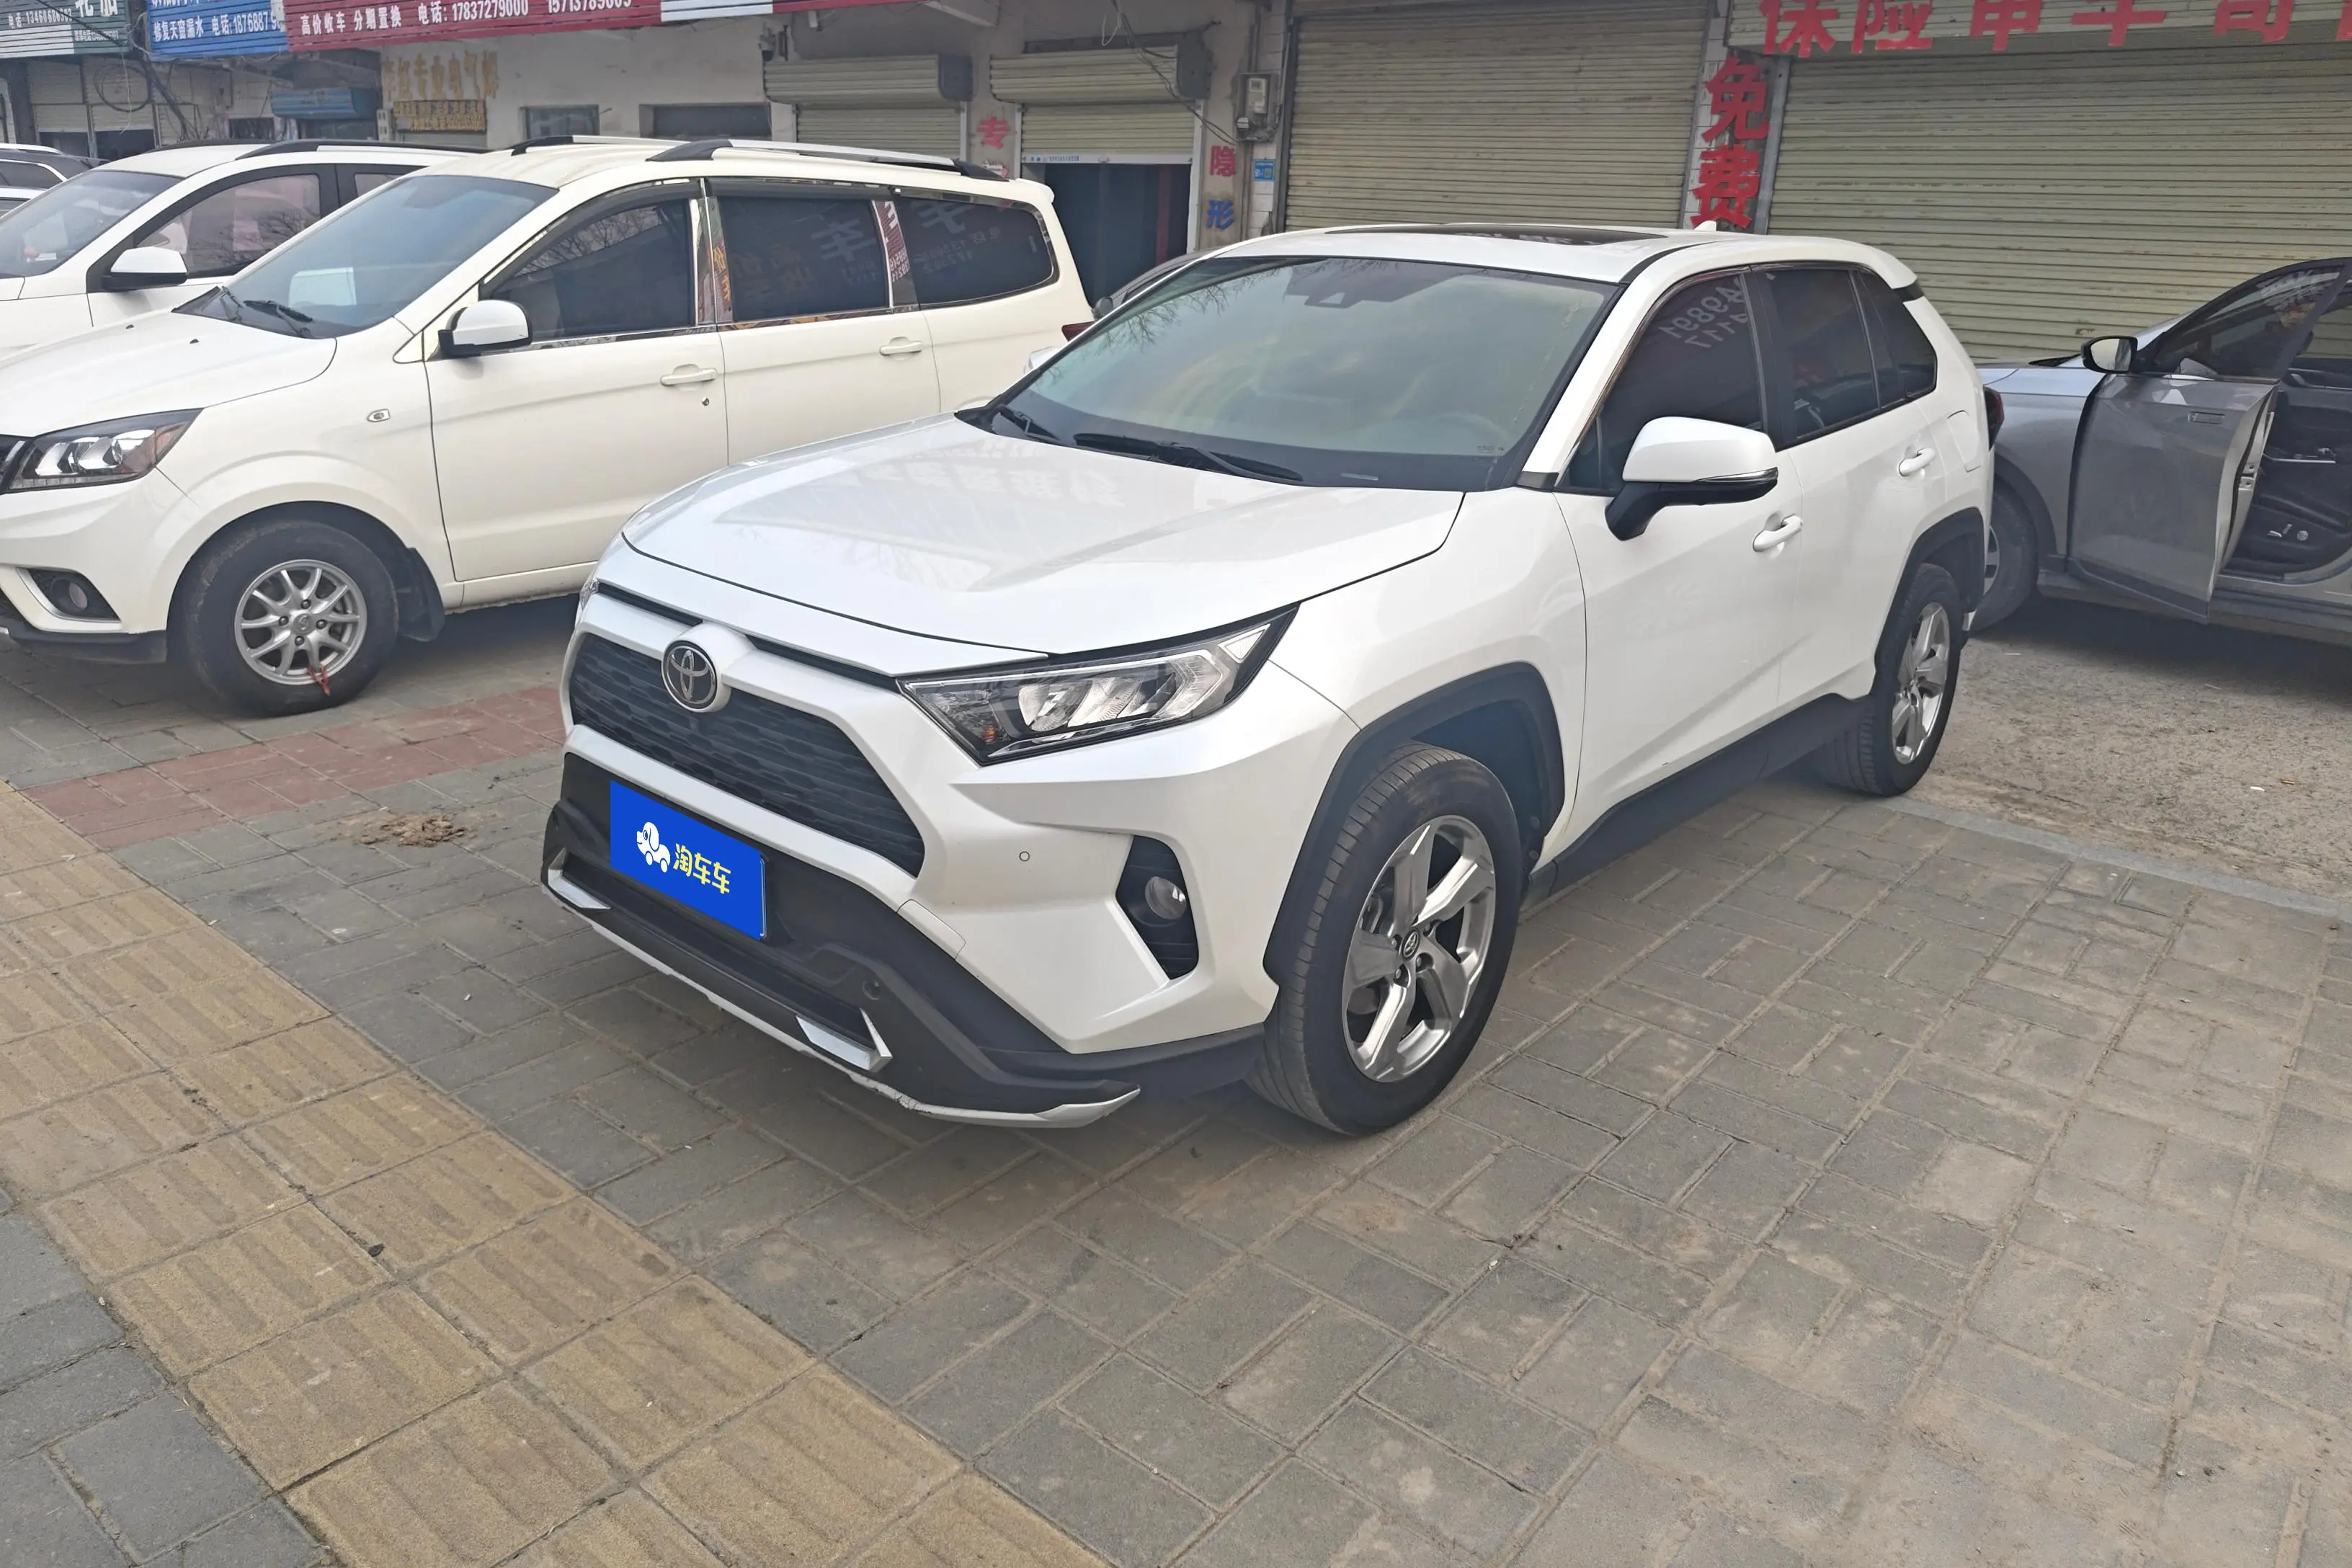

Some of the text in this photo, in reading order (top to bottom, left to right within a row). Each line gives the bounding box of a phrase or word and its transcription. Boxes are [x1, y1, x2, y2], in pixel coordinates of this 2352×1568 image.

[300, 12, 345, 35] 高价收车
[354, 5, 401, 31] 分期置换
[976, 116, 1011, 149] 专
[1690, 55, 1770, 228] 免费
[1206, 145, 1237, 230] 隐形
